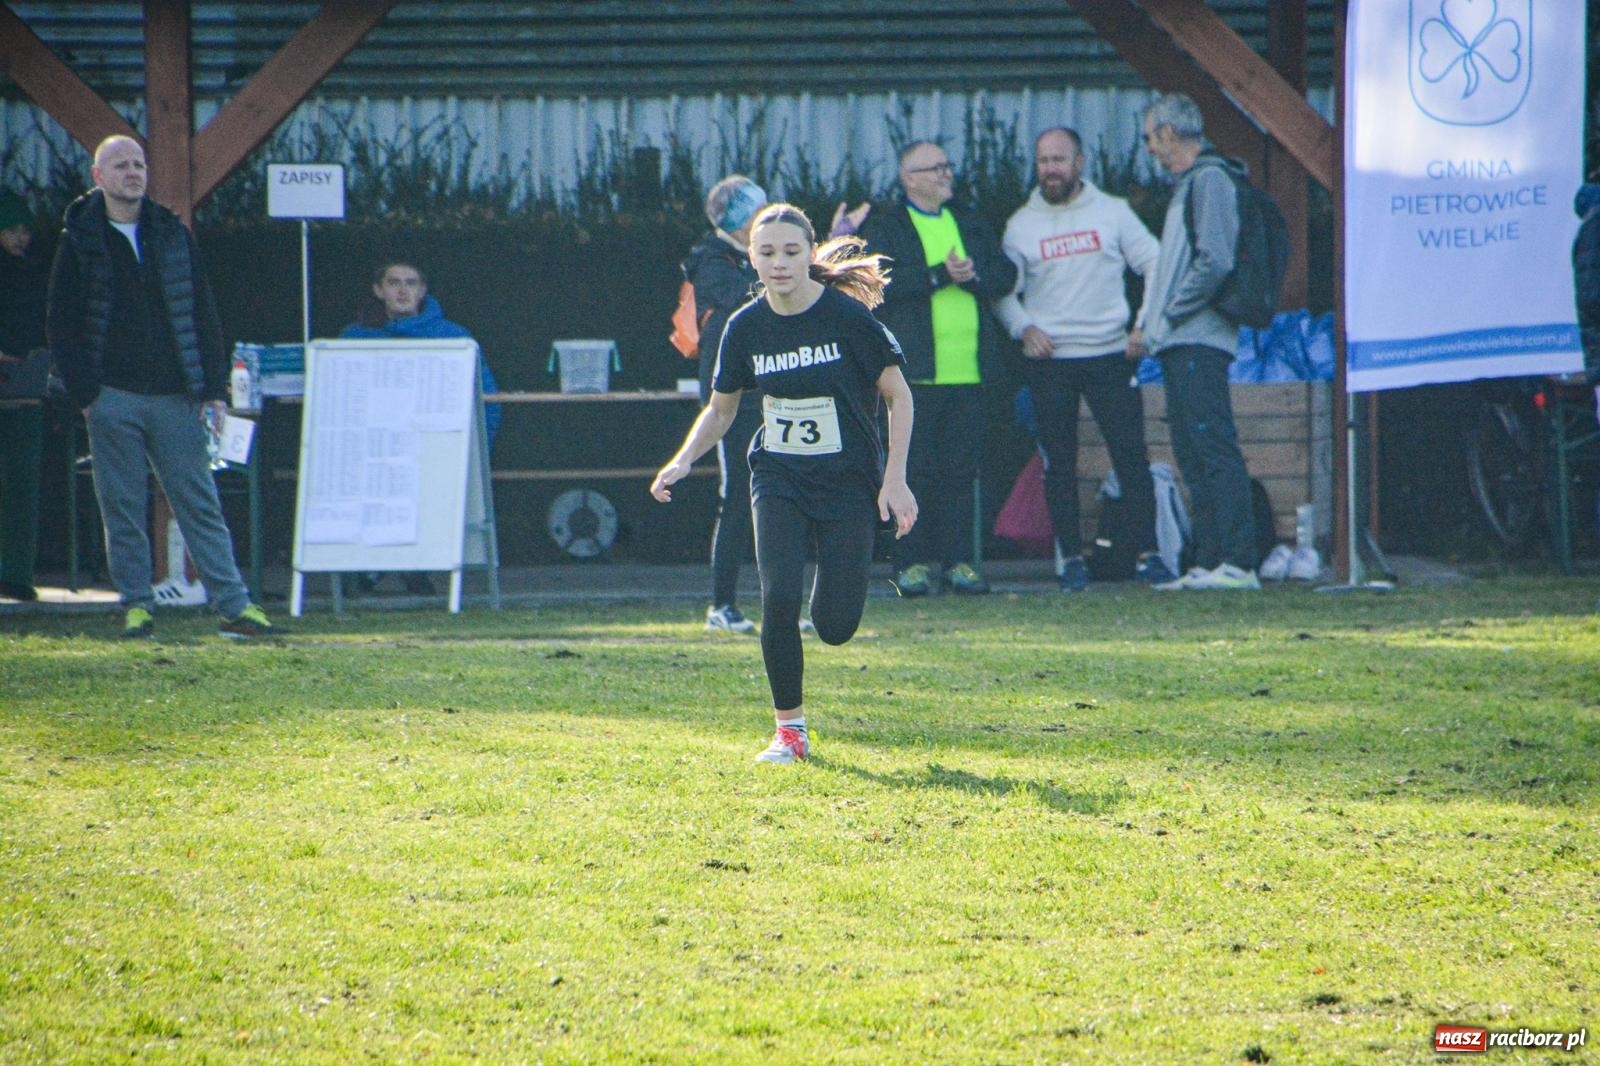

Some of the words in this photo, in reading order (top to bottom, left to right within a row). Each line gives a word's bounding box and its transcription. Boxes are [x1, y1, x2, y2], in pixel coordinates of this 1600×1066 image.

[279, 170, 332, 185] ZAPISY
[1426, 160, 1512, 180] GMINA
[1391, 185, 1548, 215] PIETROWICE
[1418, 221, 1520, 249] WIELKIE
[752, 342, 841, 376] HANDBALL
[776, 418, 822, 445] 73
